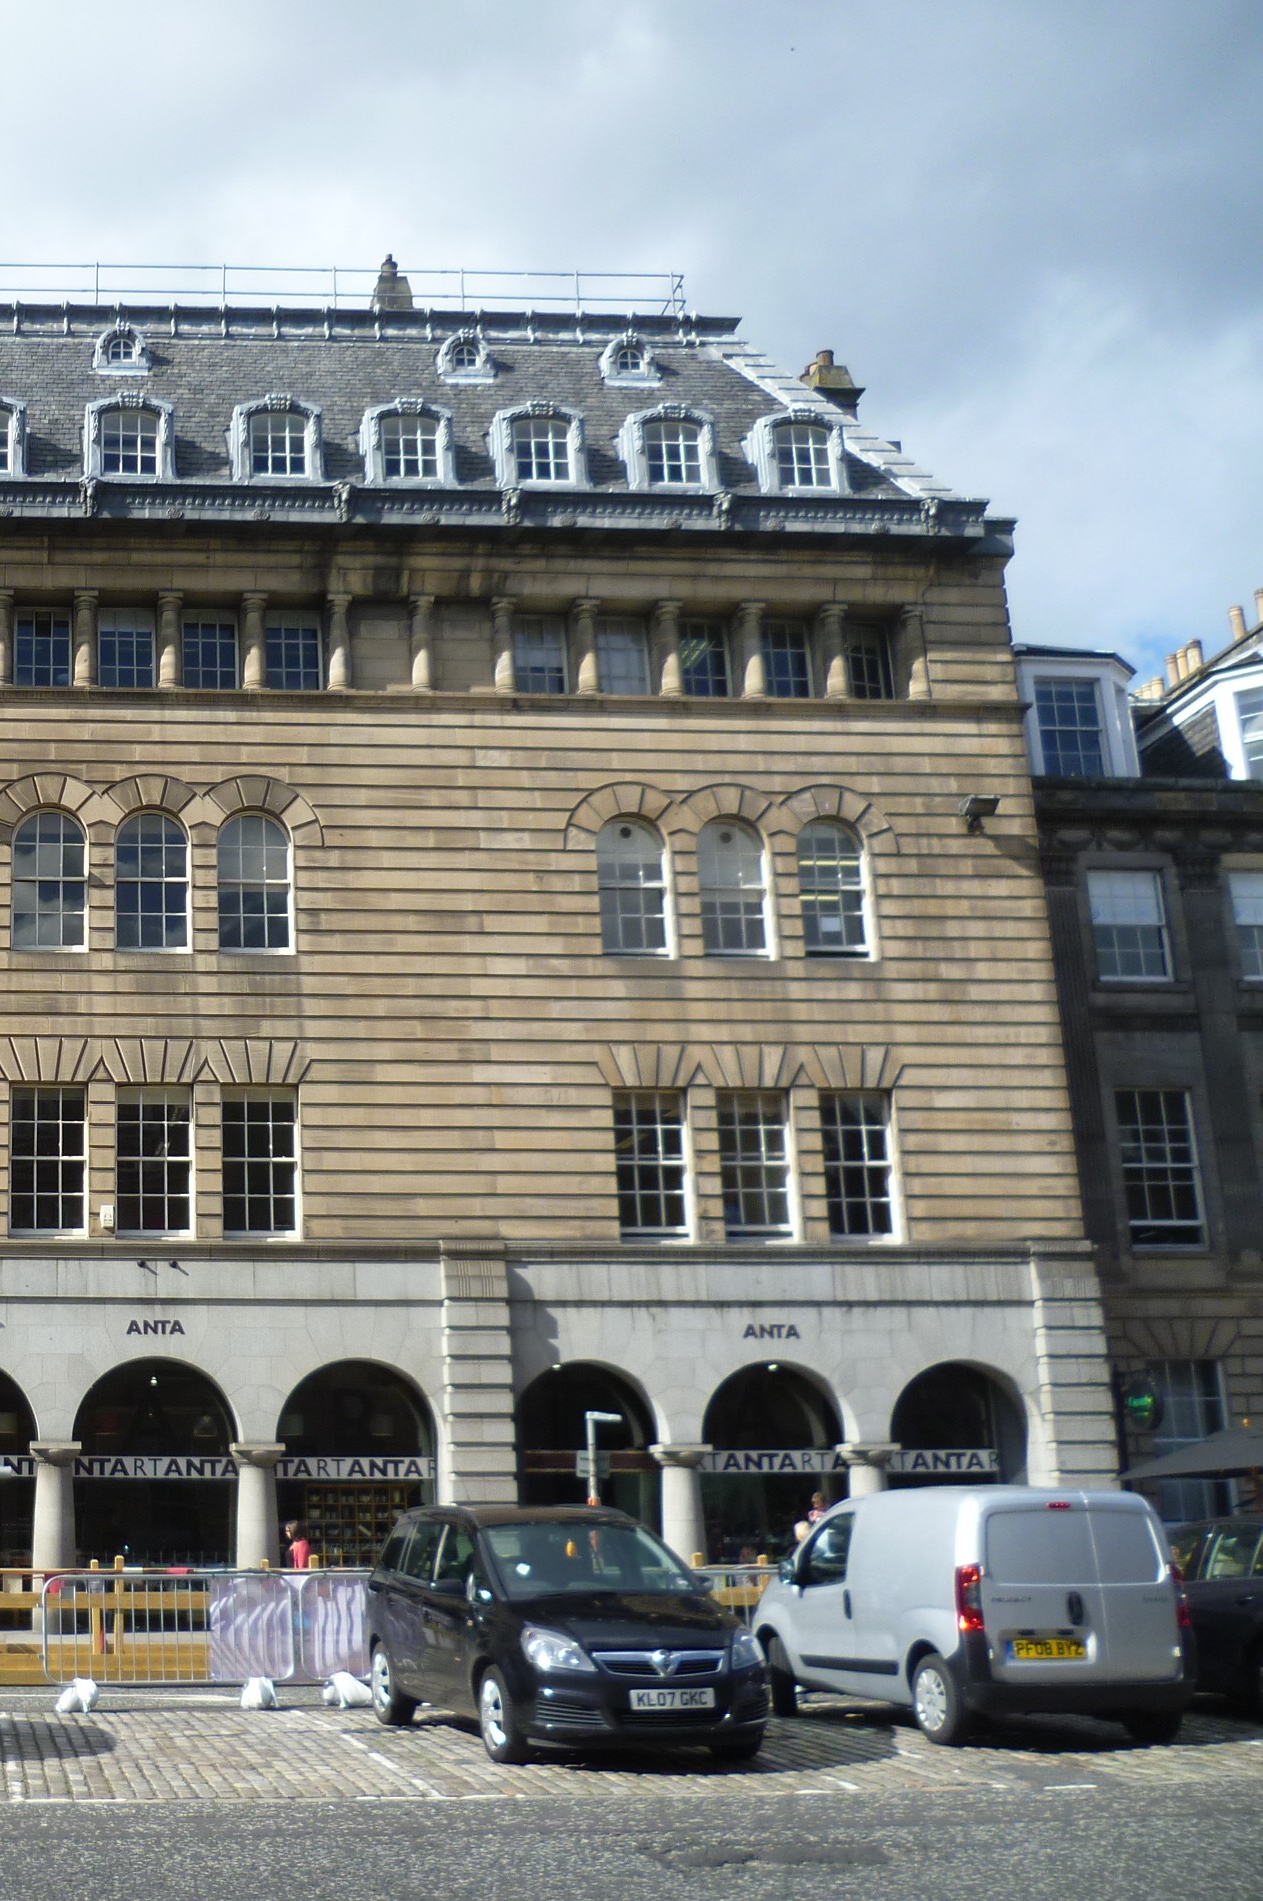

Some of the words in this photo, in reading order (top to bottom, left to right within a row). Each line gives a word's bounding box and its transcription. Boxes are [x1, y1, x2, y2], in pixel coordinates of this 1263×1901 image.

[126, 1319, 185, 1335] ANTA
[742, 1323, 801, 1339] ANTA
[637, 1691, 675, 1707] KL07
[680, 1690, 708, 1706] GKC
